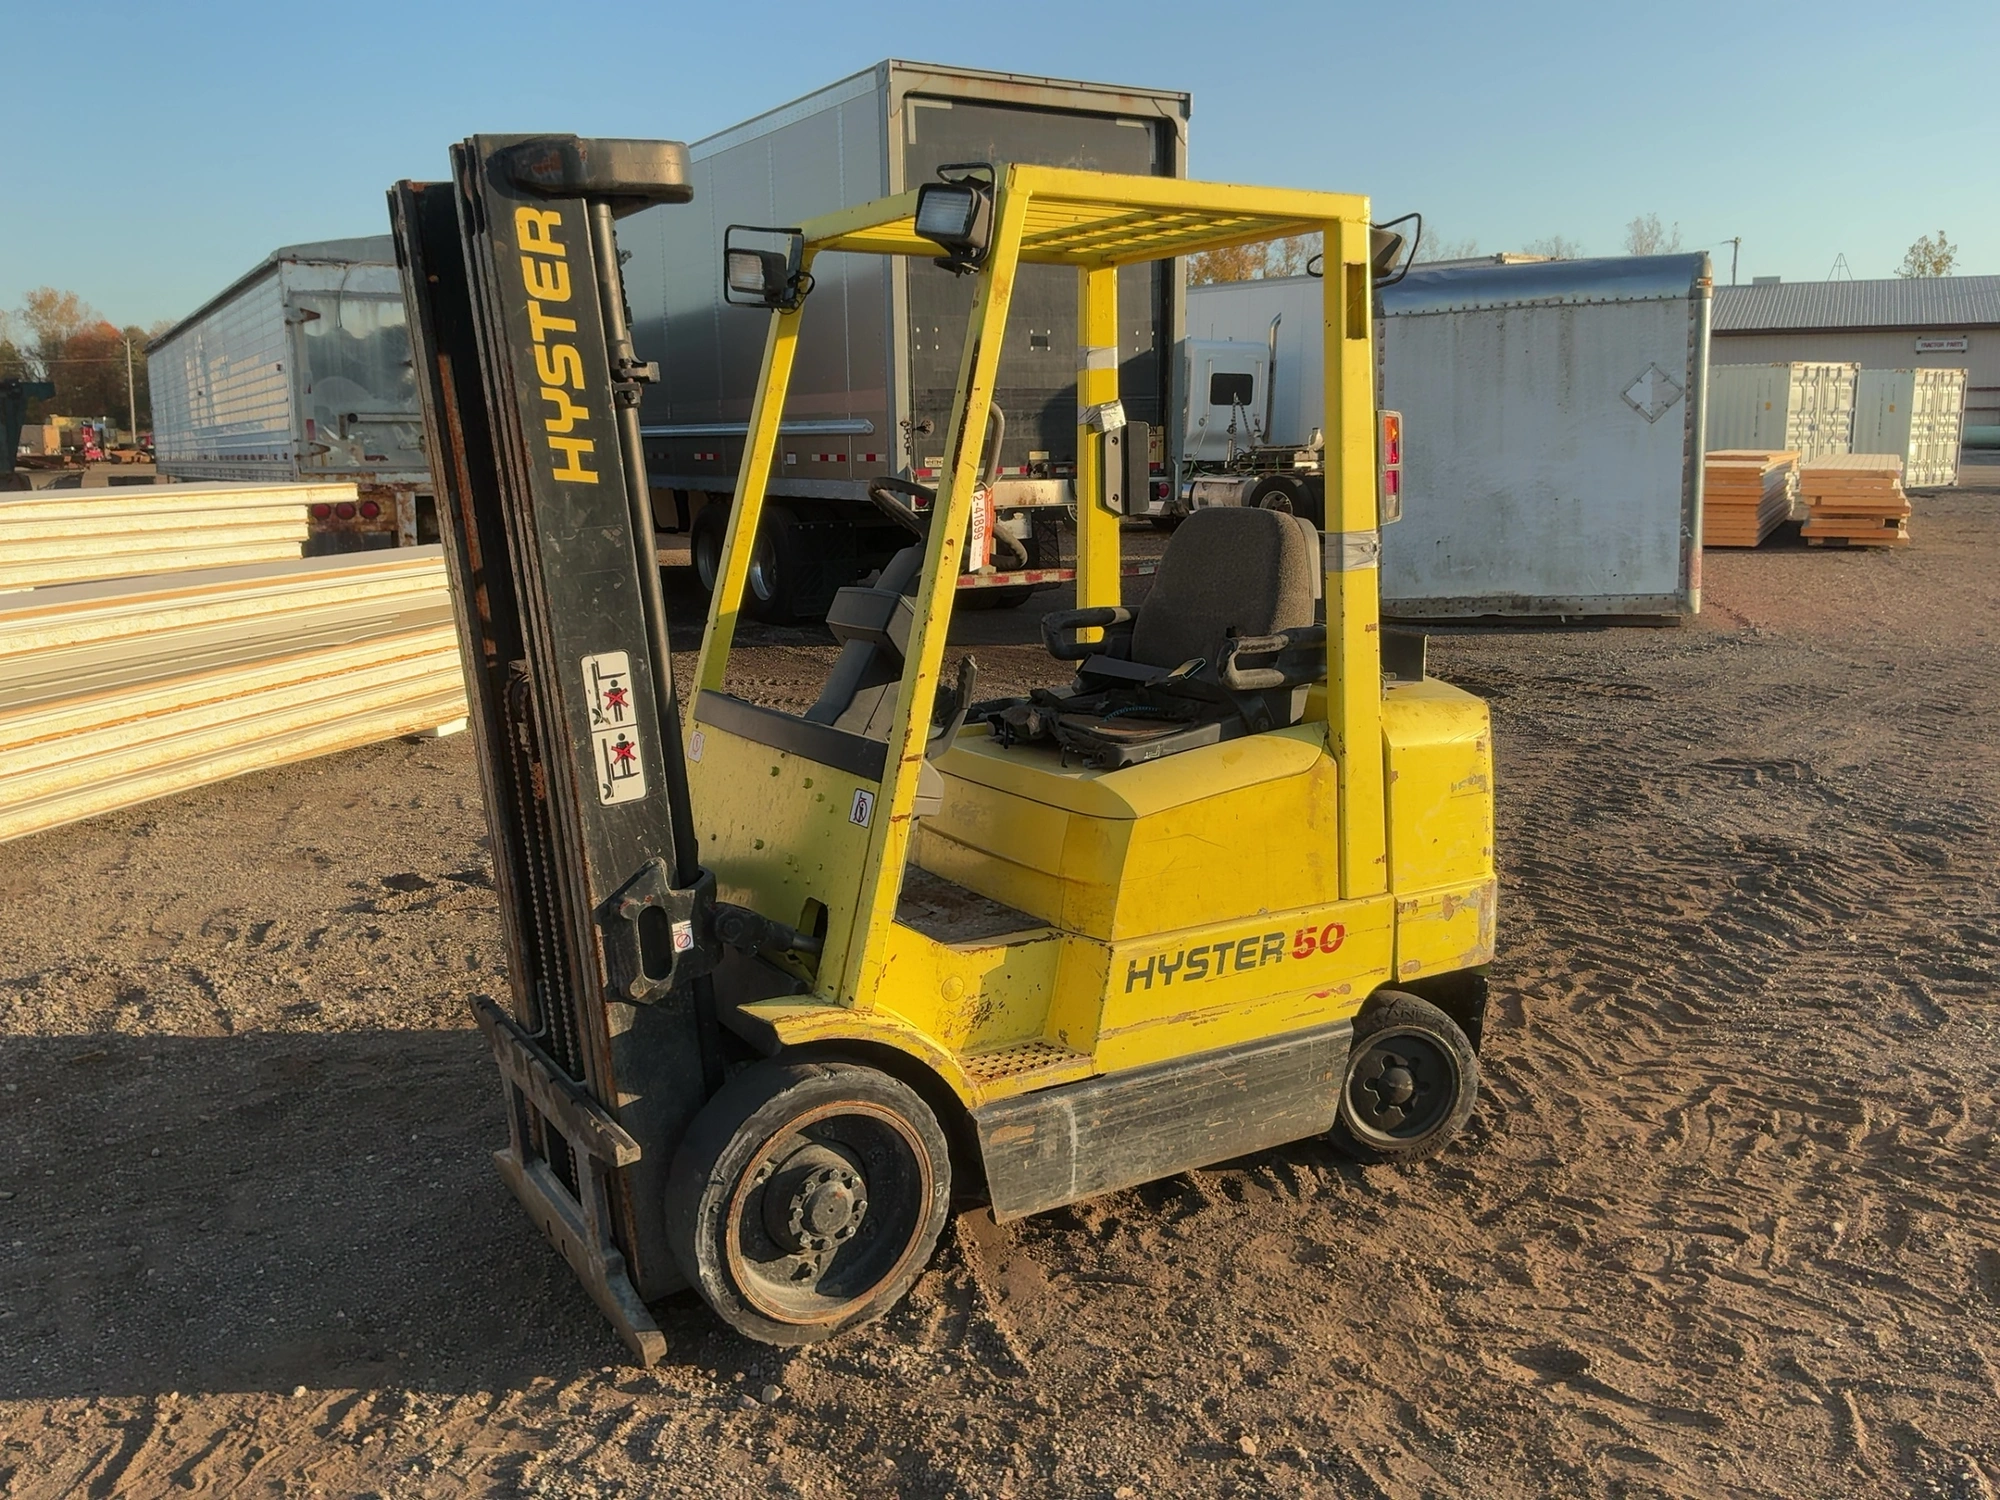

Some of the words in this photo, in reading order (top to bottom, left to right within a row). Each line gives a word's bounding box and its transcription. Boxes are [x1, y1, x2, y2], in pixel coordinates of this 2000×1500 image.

[514, 206, 599, 484] HYSTER
[972, 493, 985, 541] 2-41899
[1124, 931, 1286, 994] HYSTER
[1291, 922, 1346, 960] 50
